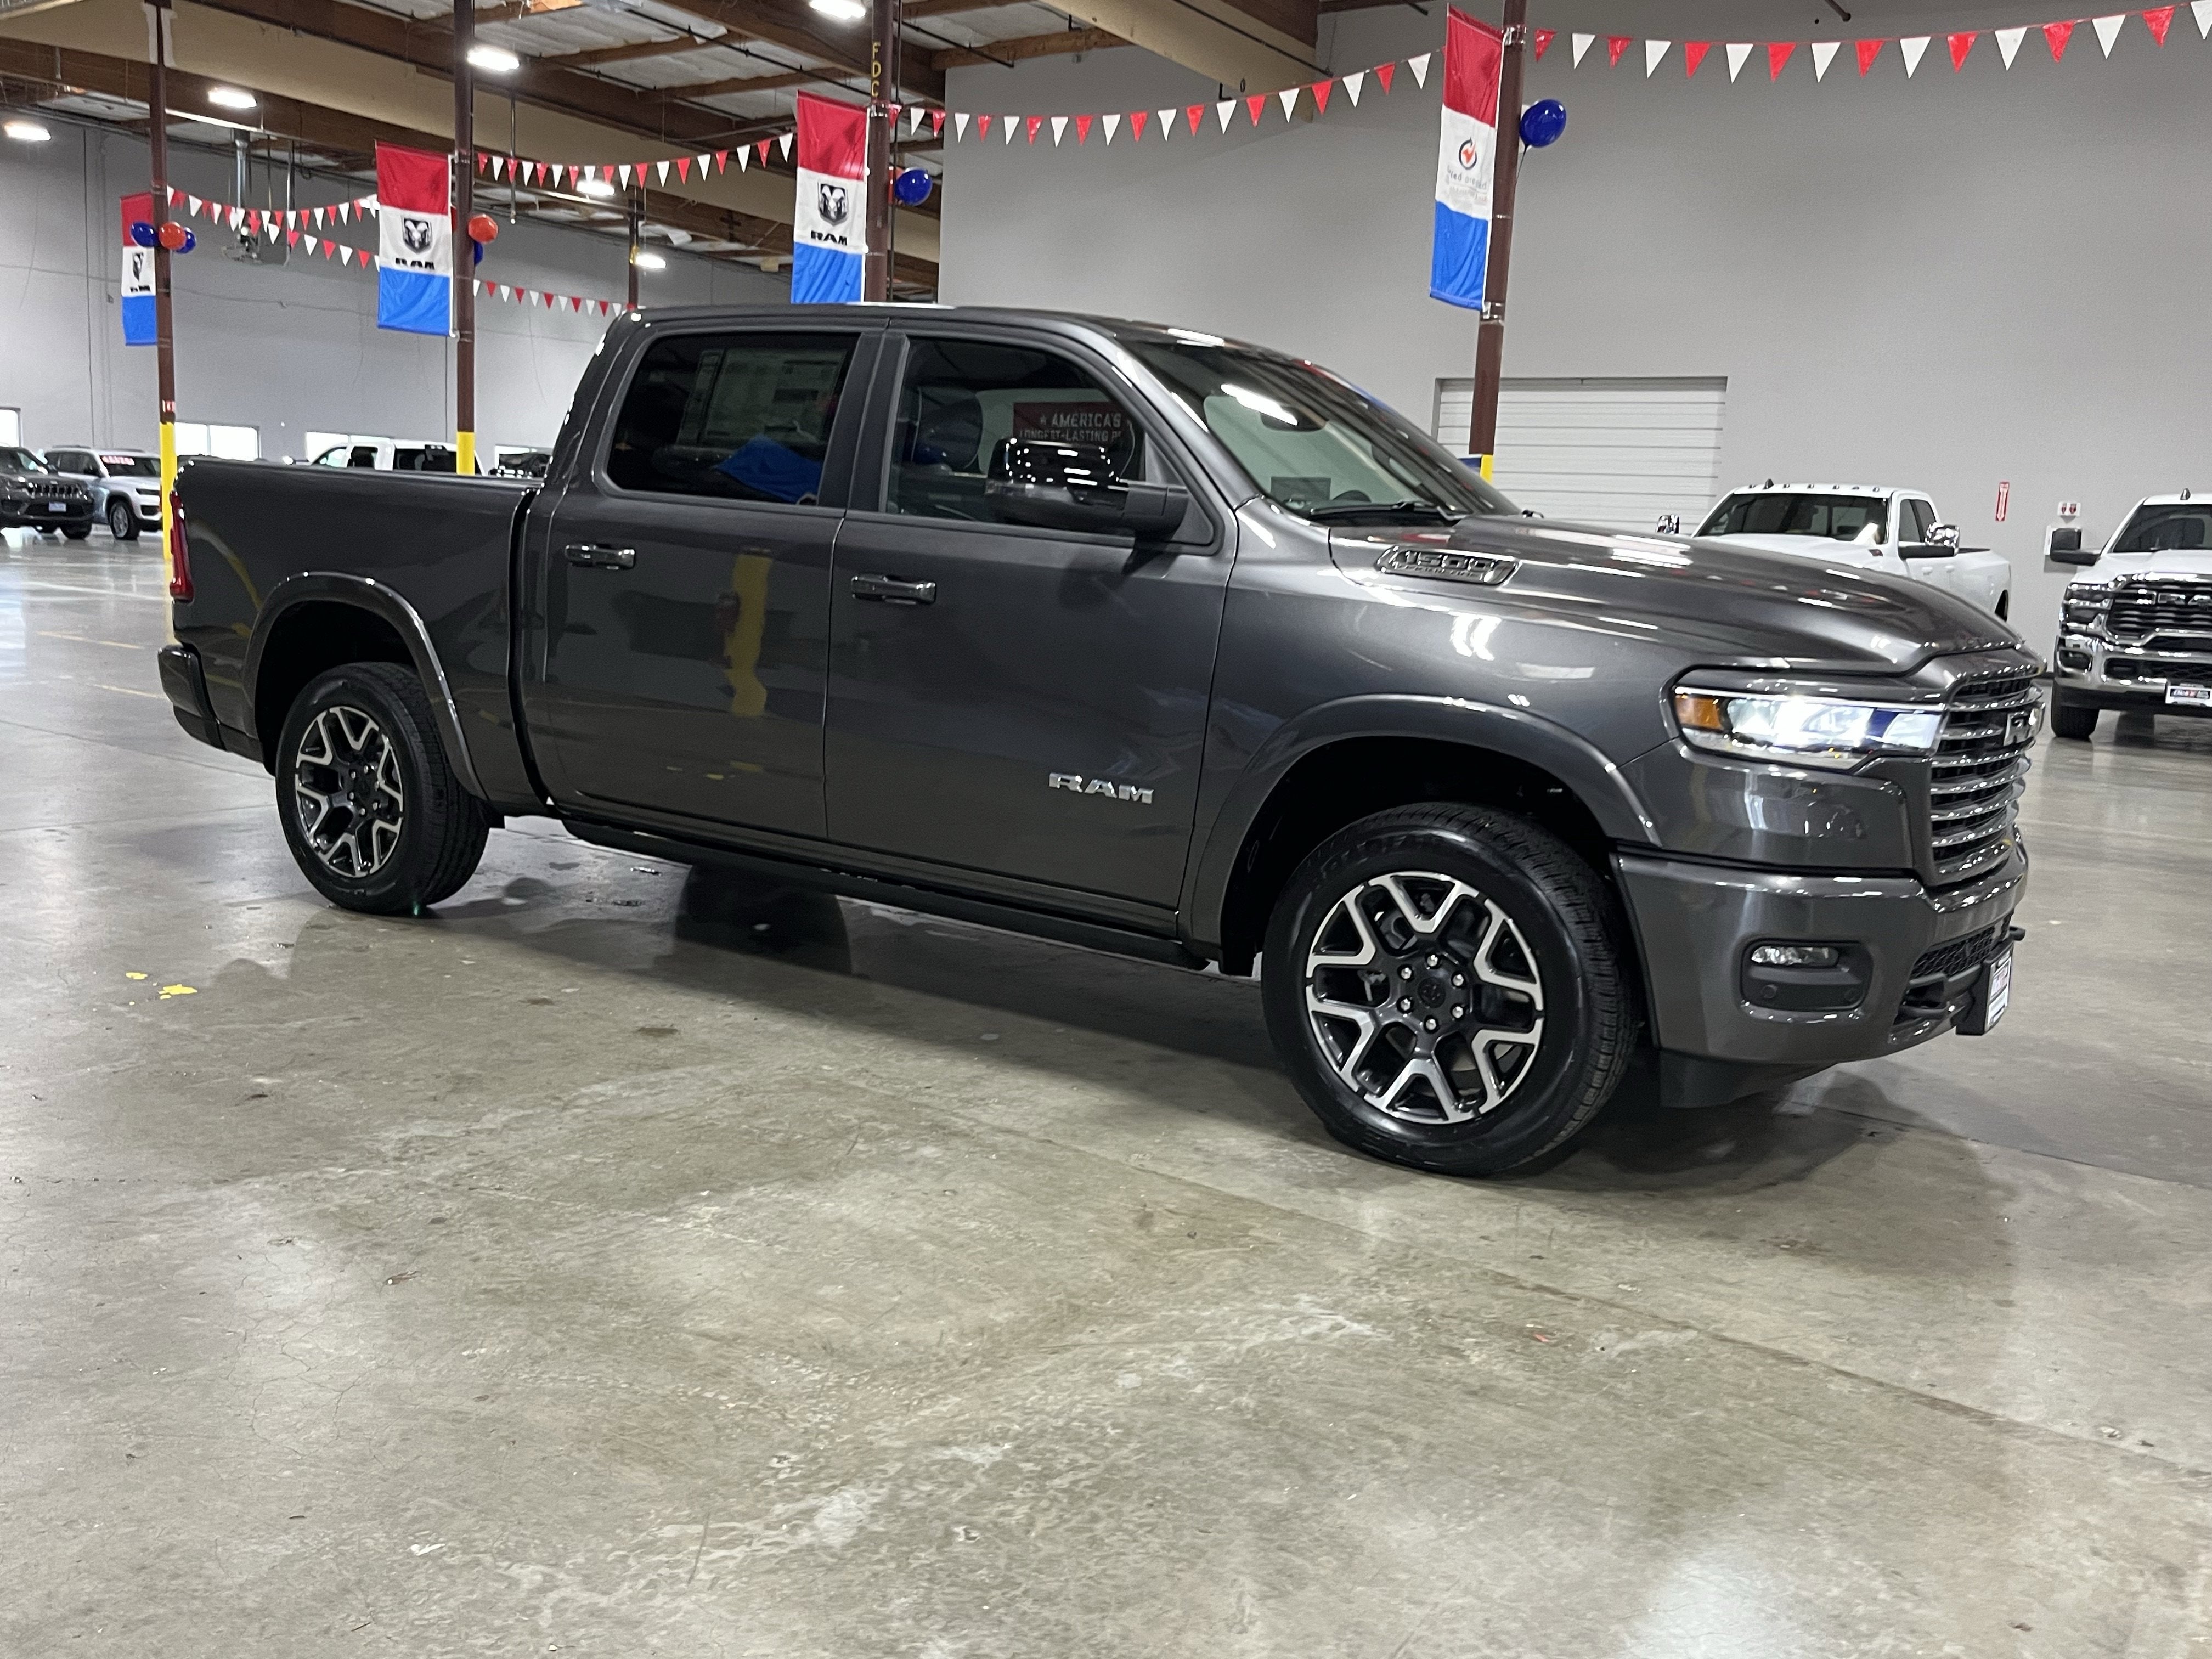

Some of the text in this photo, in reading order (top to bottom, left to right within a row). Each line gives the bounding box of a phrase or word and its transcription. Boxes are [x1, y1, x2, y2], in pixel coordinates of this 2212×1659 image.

[871, 41, 882, 97] FDC
[811, 230, 848, 246] RAM
[1052, 413, 1122, 428] AMERICA'S
[1049, 772, 1154, 804] RAM
